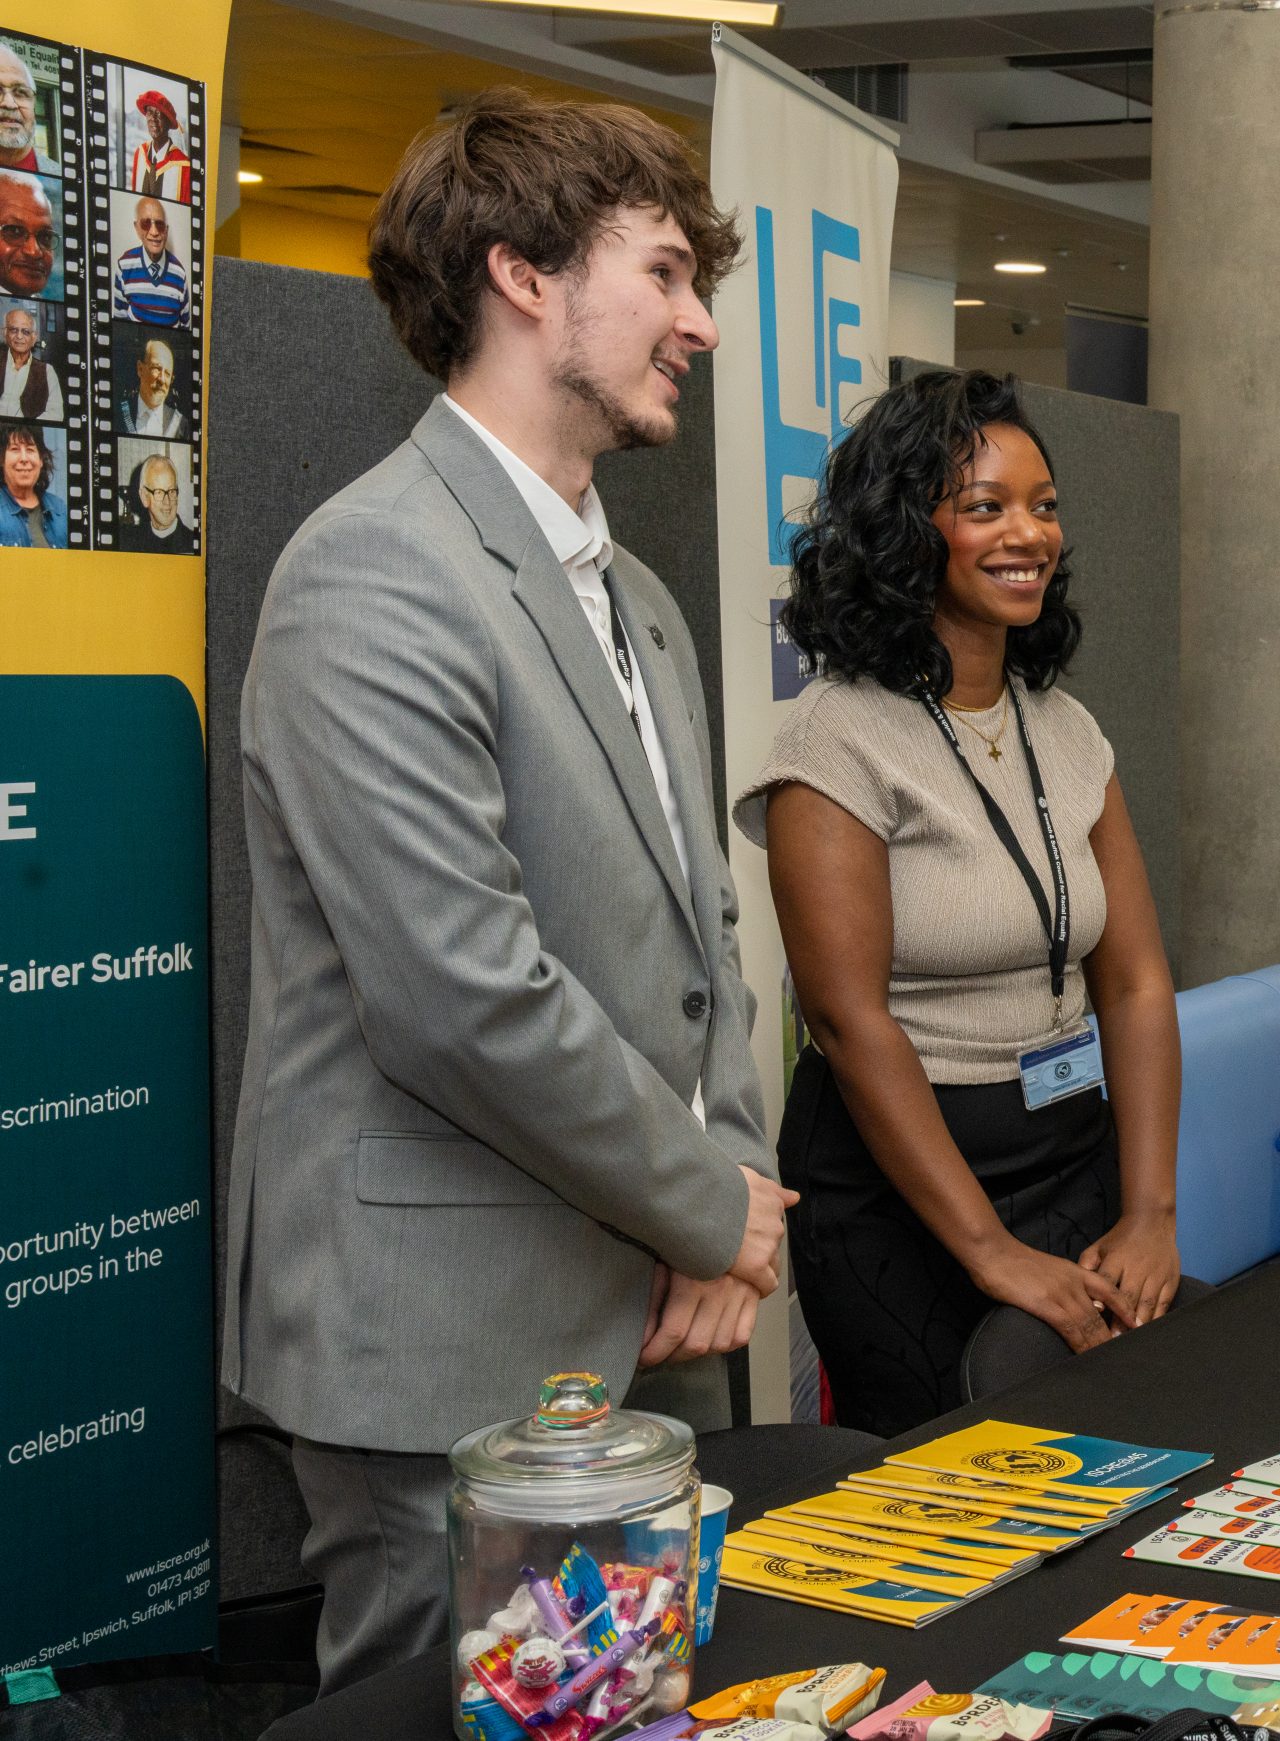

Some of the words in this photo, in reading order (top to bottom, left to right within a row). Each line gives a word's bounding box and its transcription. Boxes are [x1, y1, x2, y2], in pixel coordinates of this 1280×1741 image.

[1059, 919, 1067, 942] Equality
[91, 942, 193, 983] Suffolk
[111, 1198, 199, 1239] between
[5, 1264, 93, 1308] groups
[100, 1256, 118, 1280] in
[125, 1246, 162, 1272] the
[8, 1406, 145, 1464] celebrating
[126, 1538, 210, 1584] www.iscre.org.uk
[148, 1576, 182, 1598] 01473
[39, 1637, 80, 1662] Street,
[82, 1617, 129, 1646] Ipswich,
[131, 1600, 176, 1625] Suffolk,
[193, 1580, 210, 1600] 3EP
